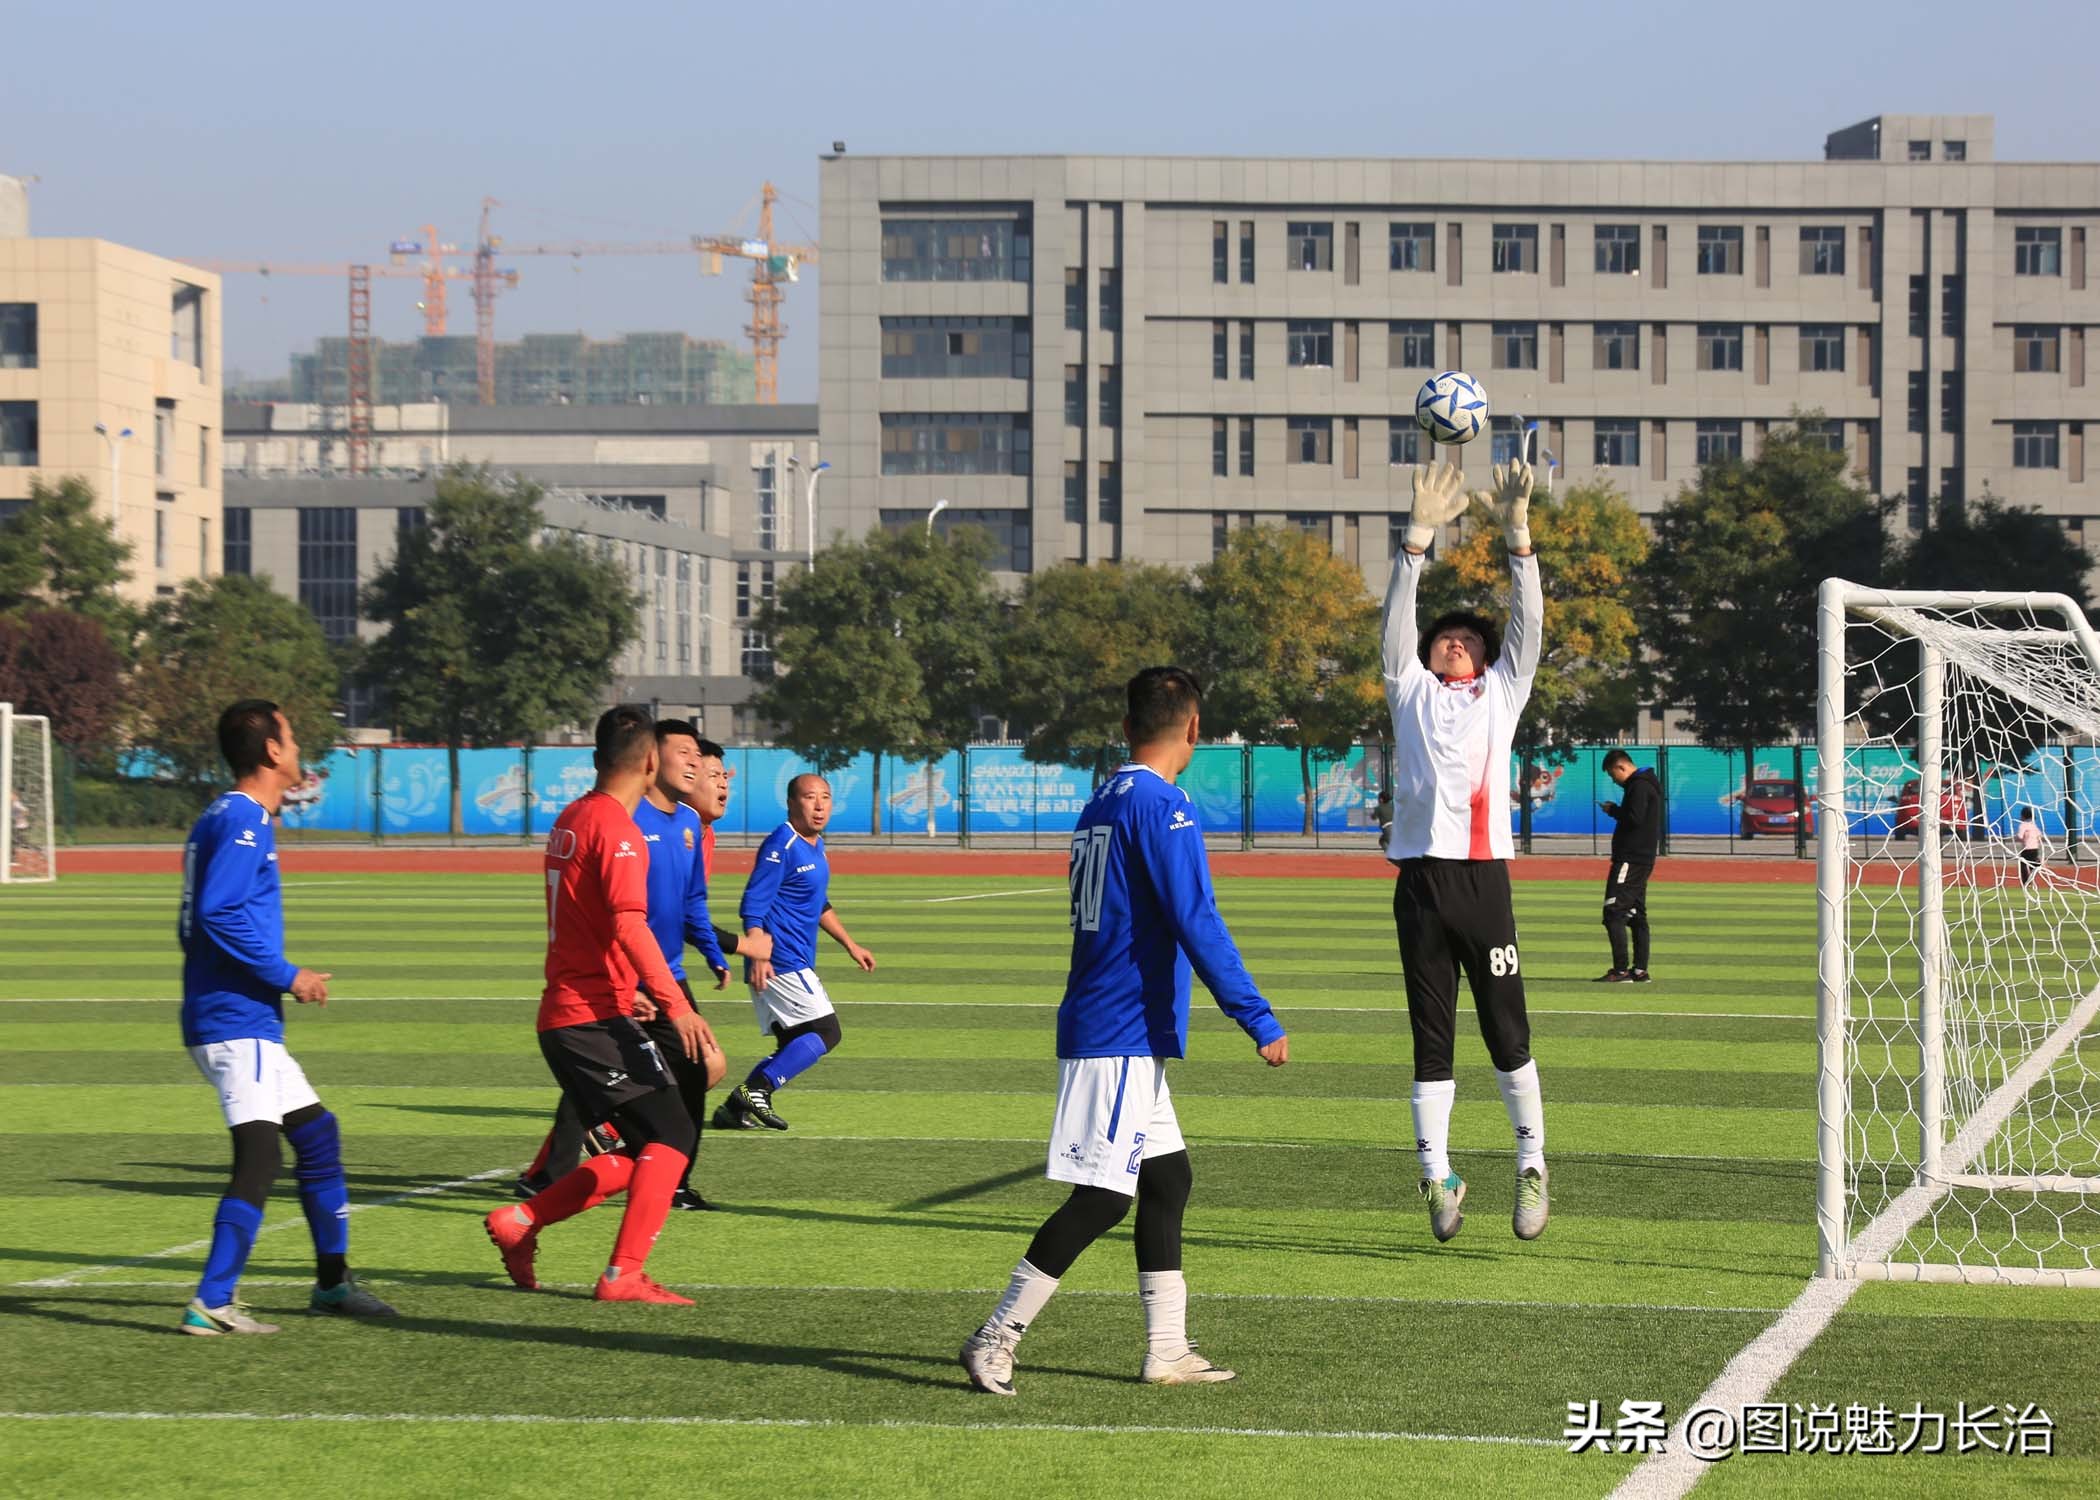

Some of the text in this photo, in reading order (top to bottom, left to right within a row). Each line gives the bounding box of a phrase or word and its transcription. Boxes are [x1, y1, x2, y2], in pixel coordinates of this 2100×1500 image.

[1169, 820, 1195, 831] KELME
[1070, 826, 1113, 932] 20
[1489, 944, 1519, 977] 89
[1060, 1152, 1085, 1162] KELME
